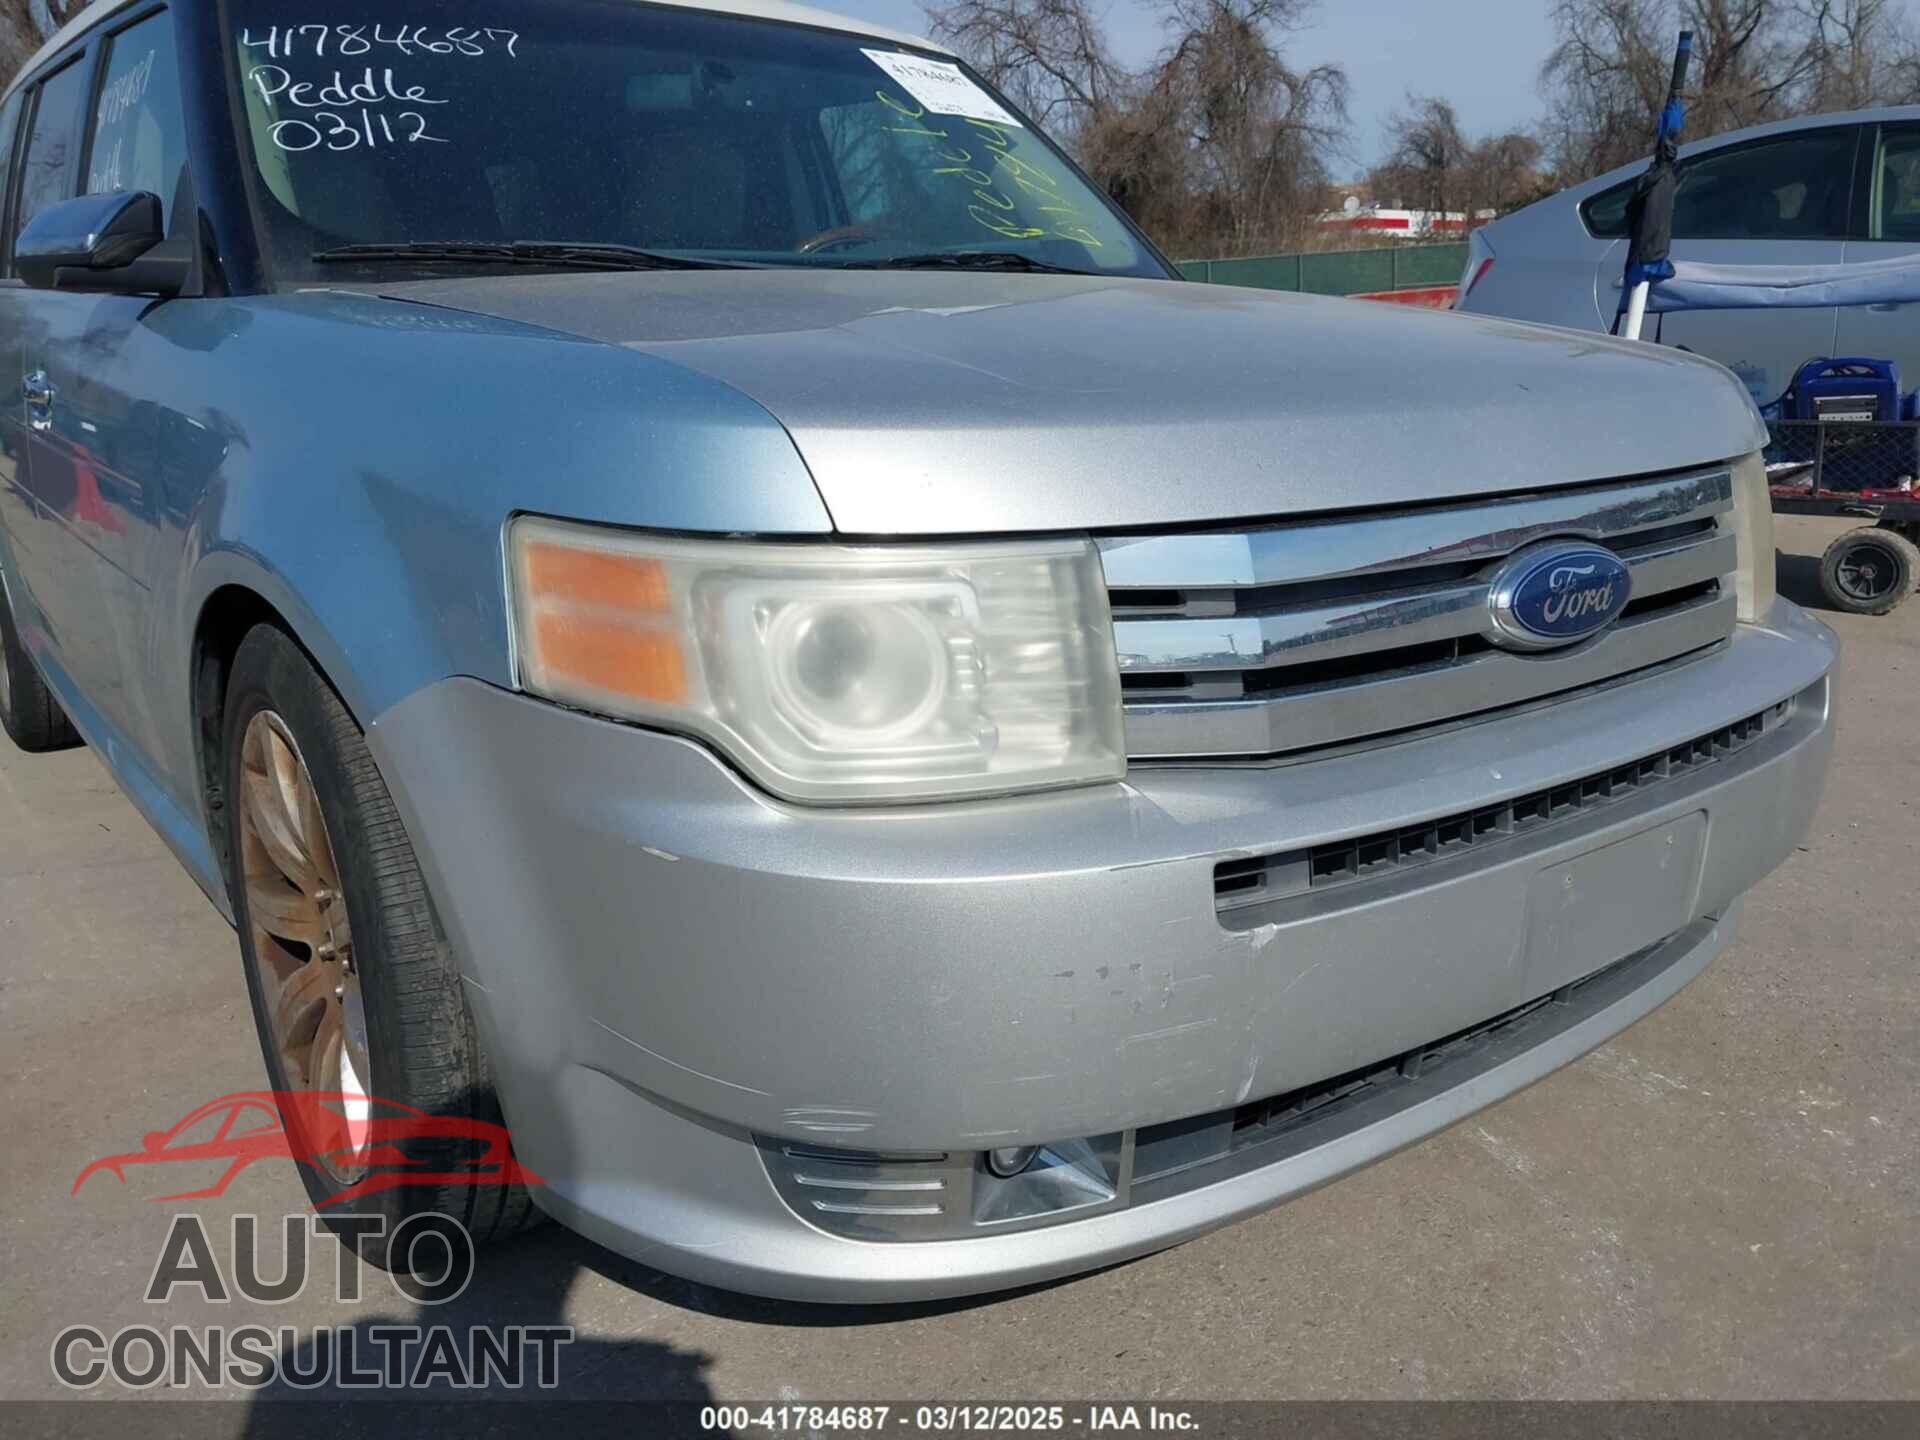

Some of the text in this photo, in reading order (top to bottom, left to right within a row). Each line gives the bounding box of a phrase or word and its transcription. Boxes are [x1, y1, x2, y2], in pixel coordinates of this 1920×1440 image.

[243, 23, 519, 58] 41784687
[249, 64, 449, 107] Peddle
[267, 108, 449, 151] 03/12
[1543, 564, 1614, 624] Ford
